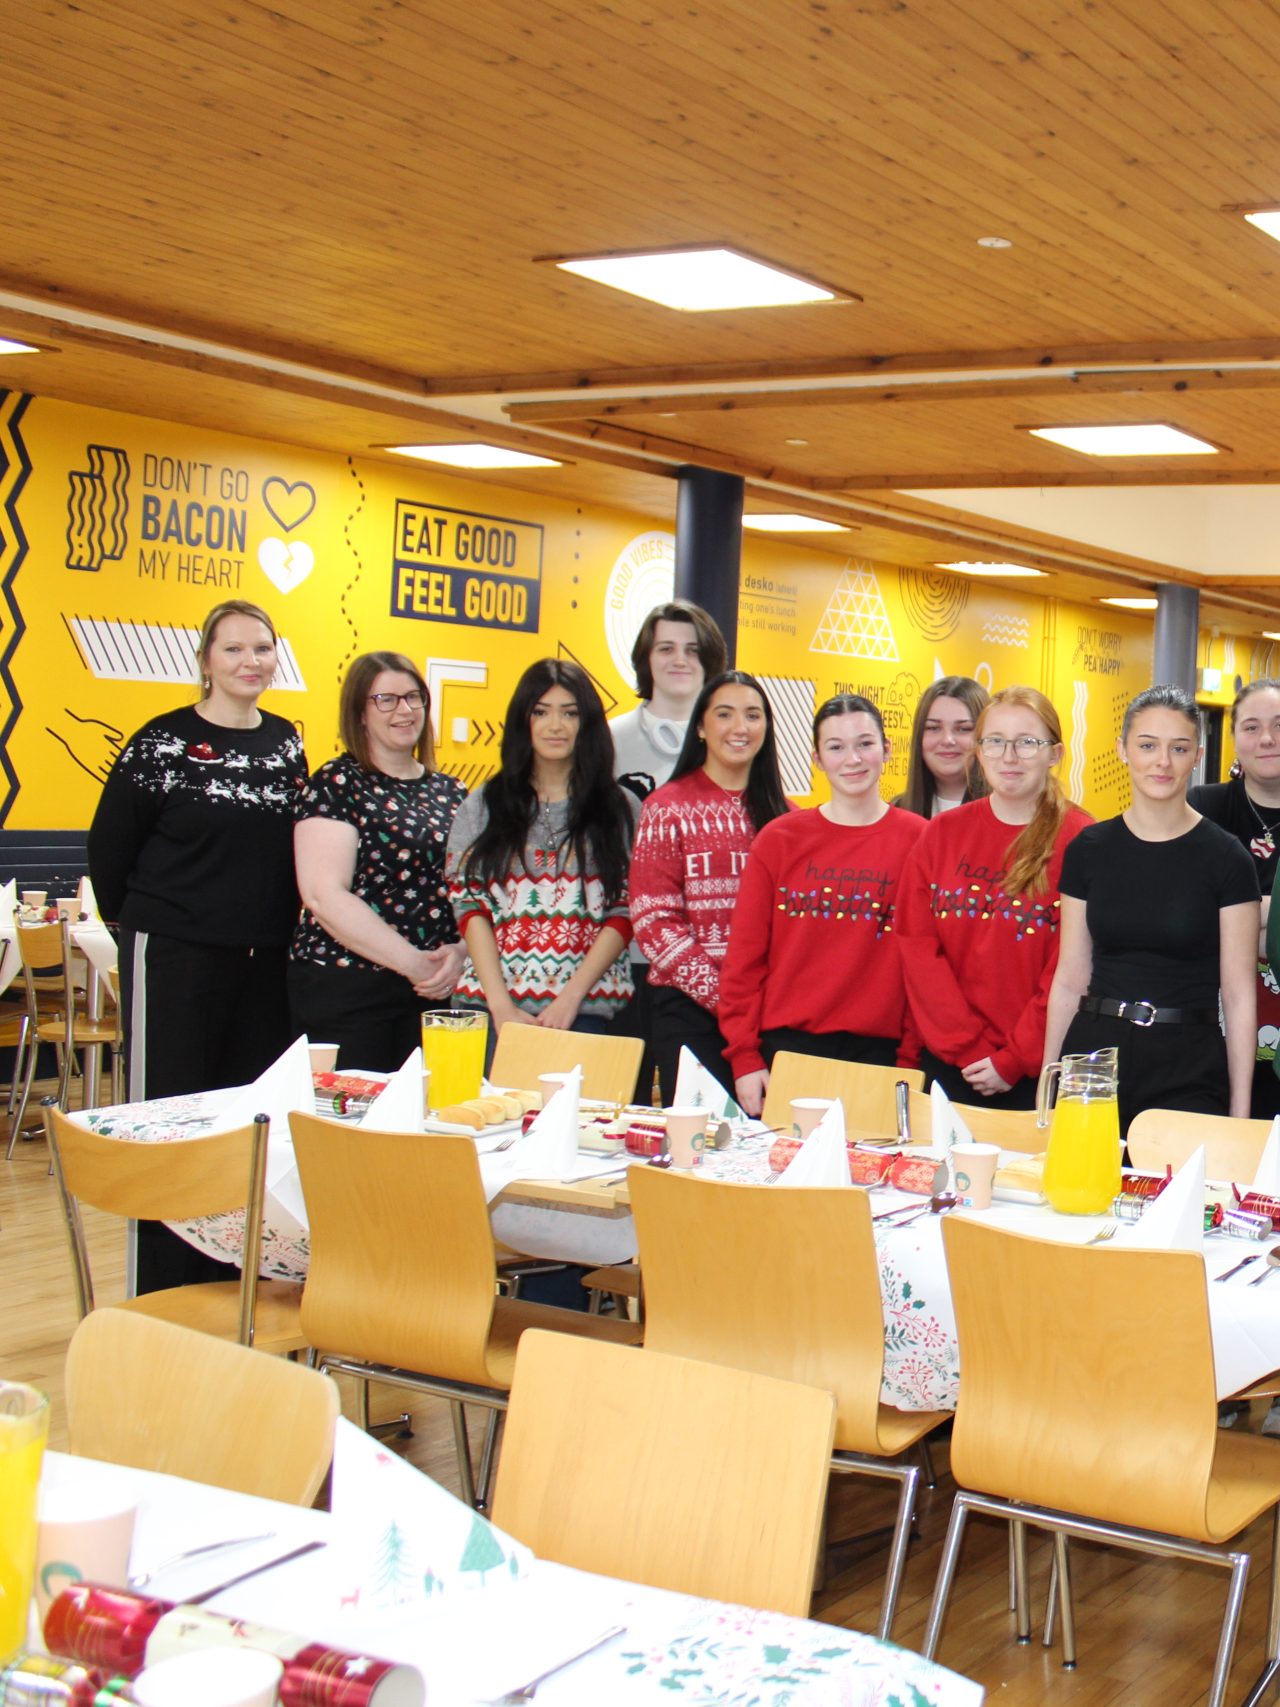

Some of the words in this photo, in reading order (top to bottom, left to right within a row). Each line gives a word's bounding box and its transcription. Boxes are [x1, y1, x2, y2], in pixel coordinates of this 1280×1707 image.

[144, 453, 212, 496] DON'T
[220, 468, 249, 502] GO
[141, 495, 248, 553] BACON
[401, 511, 447, 557] EAT
[455, 522, 516, 568] GOOD
[138, 547, 168, 581] MY
[177, 554, 244, 589] HEART
[610, 562, 633, 610] GOOD
[630, 539, 664, 568] VIBES
[744, 574, 774, 591] desko
[397, 567, 456, 617] FEEL
[464, 578, 527, 624] GOOD
[768, 622, 796, 636] working
[1083, 653, 1097, 673] PEA
[1098, 656, 1121, 677] HAPPY
[856, 684, 885, 705] MIGHT
[686, 851, 713, 877] ET
[730, 851, 749, 875] IT
[806, 858, 896, 897] happy
[955, 854, 1008, 894] hap
[783, 884, 894, 935] holiday
